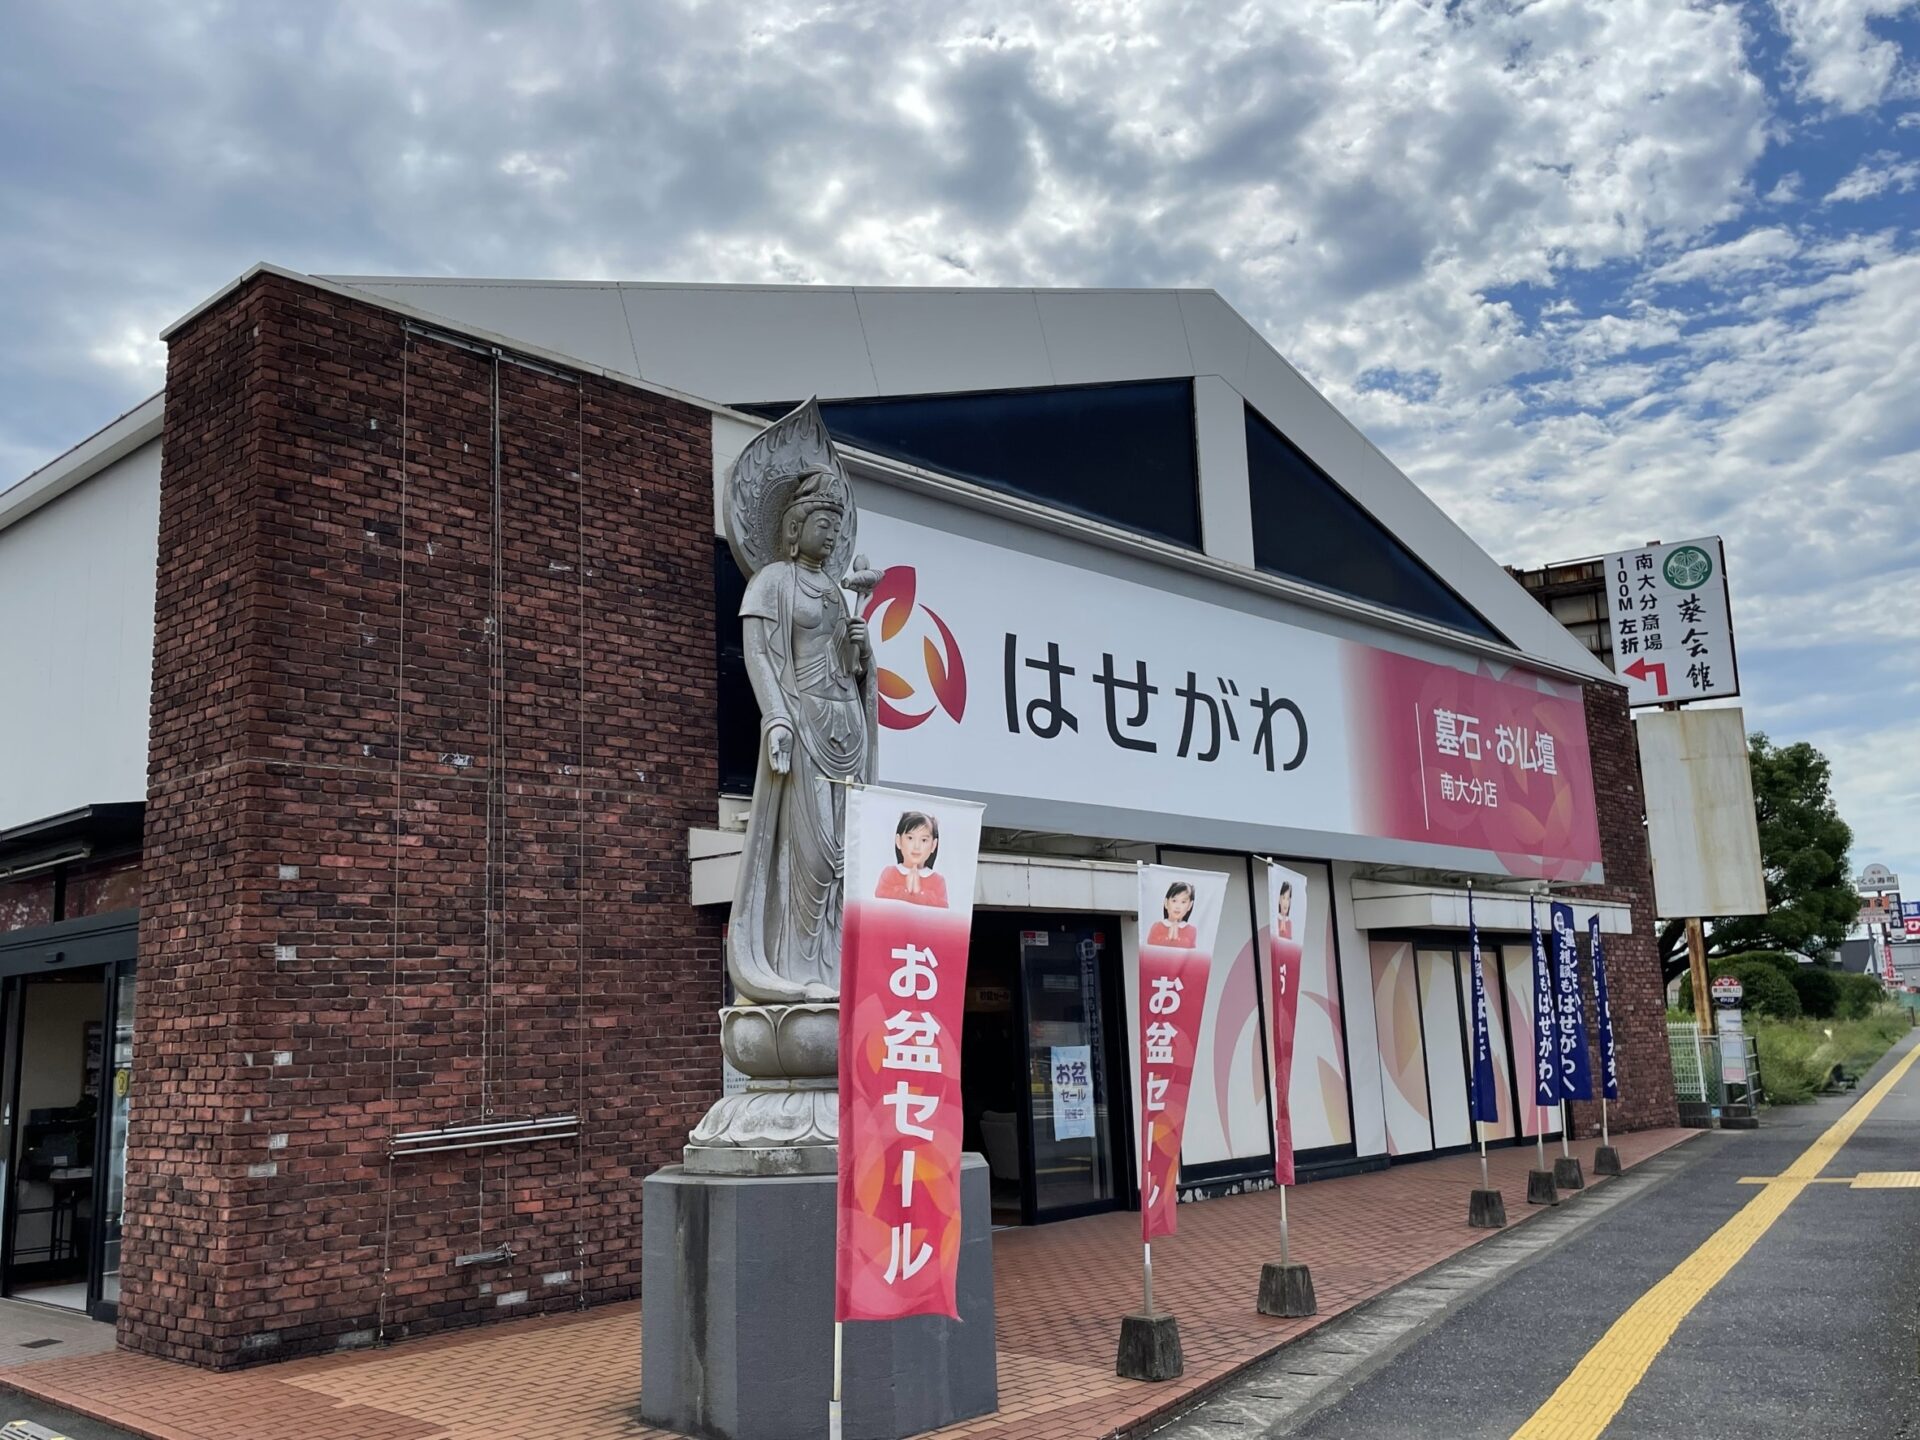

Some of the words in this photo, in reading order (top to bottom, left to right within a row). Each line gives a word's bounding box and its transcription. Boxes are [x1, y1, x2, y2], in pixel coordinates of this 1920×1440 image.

[1677, 593, 1714, 691] 葵会館
[1004, 632, 1309, 772] はせがわ
[1434, 708, 1557, 775] 墓石・お仏壇
[1440, 772, 1497, 808] 南大分店
[1056, 1062, 1088, 1086] お盆
[1061, 1088, 1086, 1102] セール
[882, 943, 942, 1285] お盆セール
